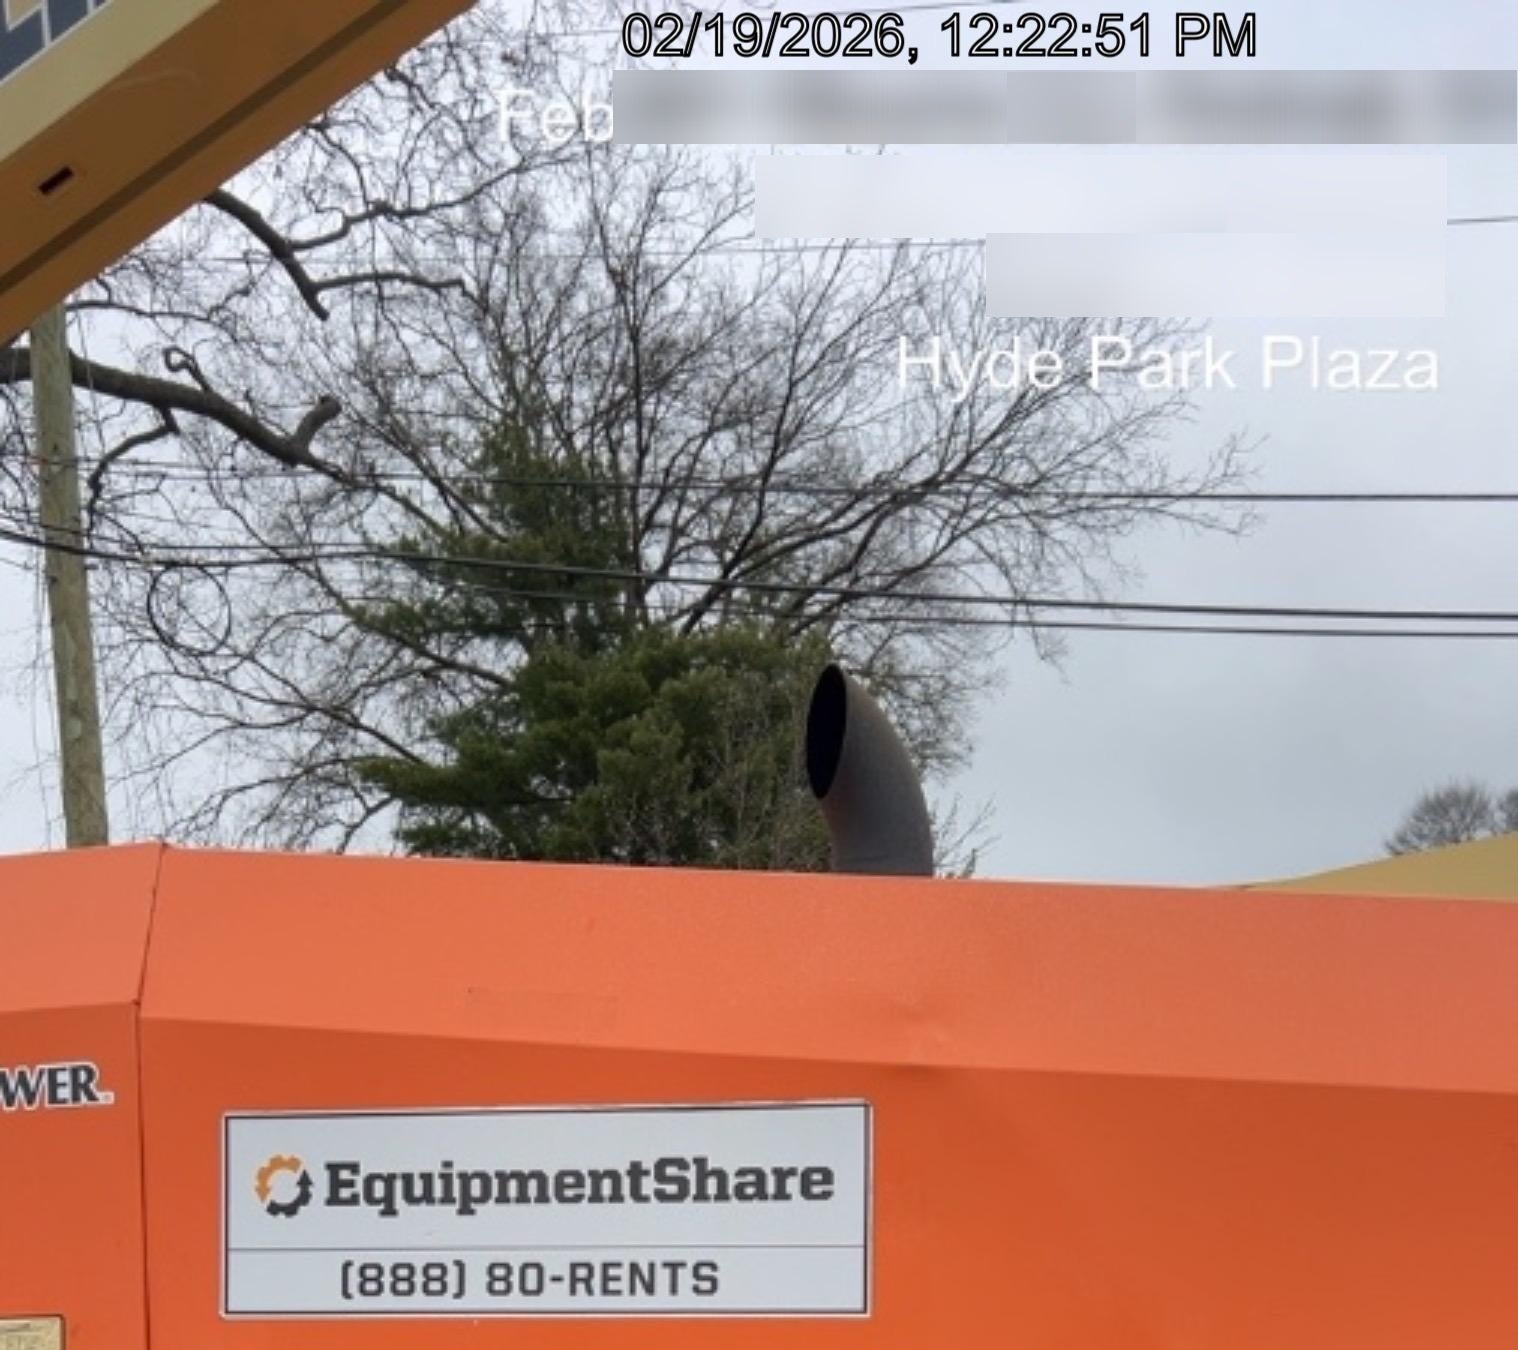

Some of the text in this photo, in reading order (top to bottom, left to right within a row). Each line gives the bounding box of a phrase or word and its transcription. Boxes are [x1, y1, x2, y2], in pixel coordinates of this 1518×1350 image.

[324, 1156, 835, 1218] EquipmentShare
[340, 1260, 720, 1300] (888) 80-RENTS
